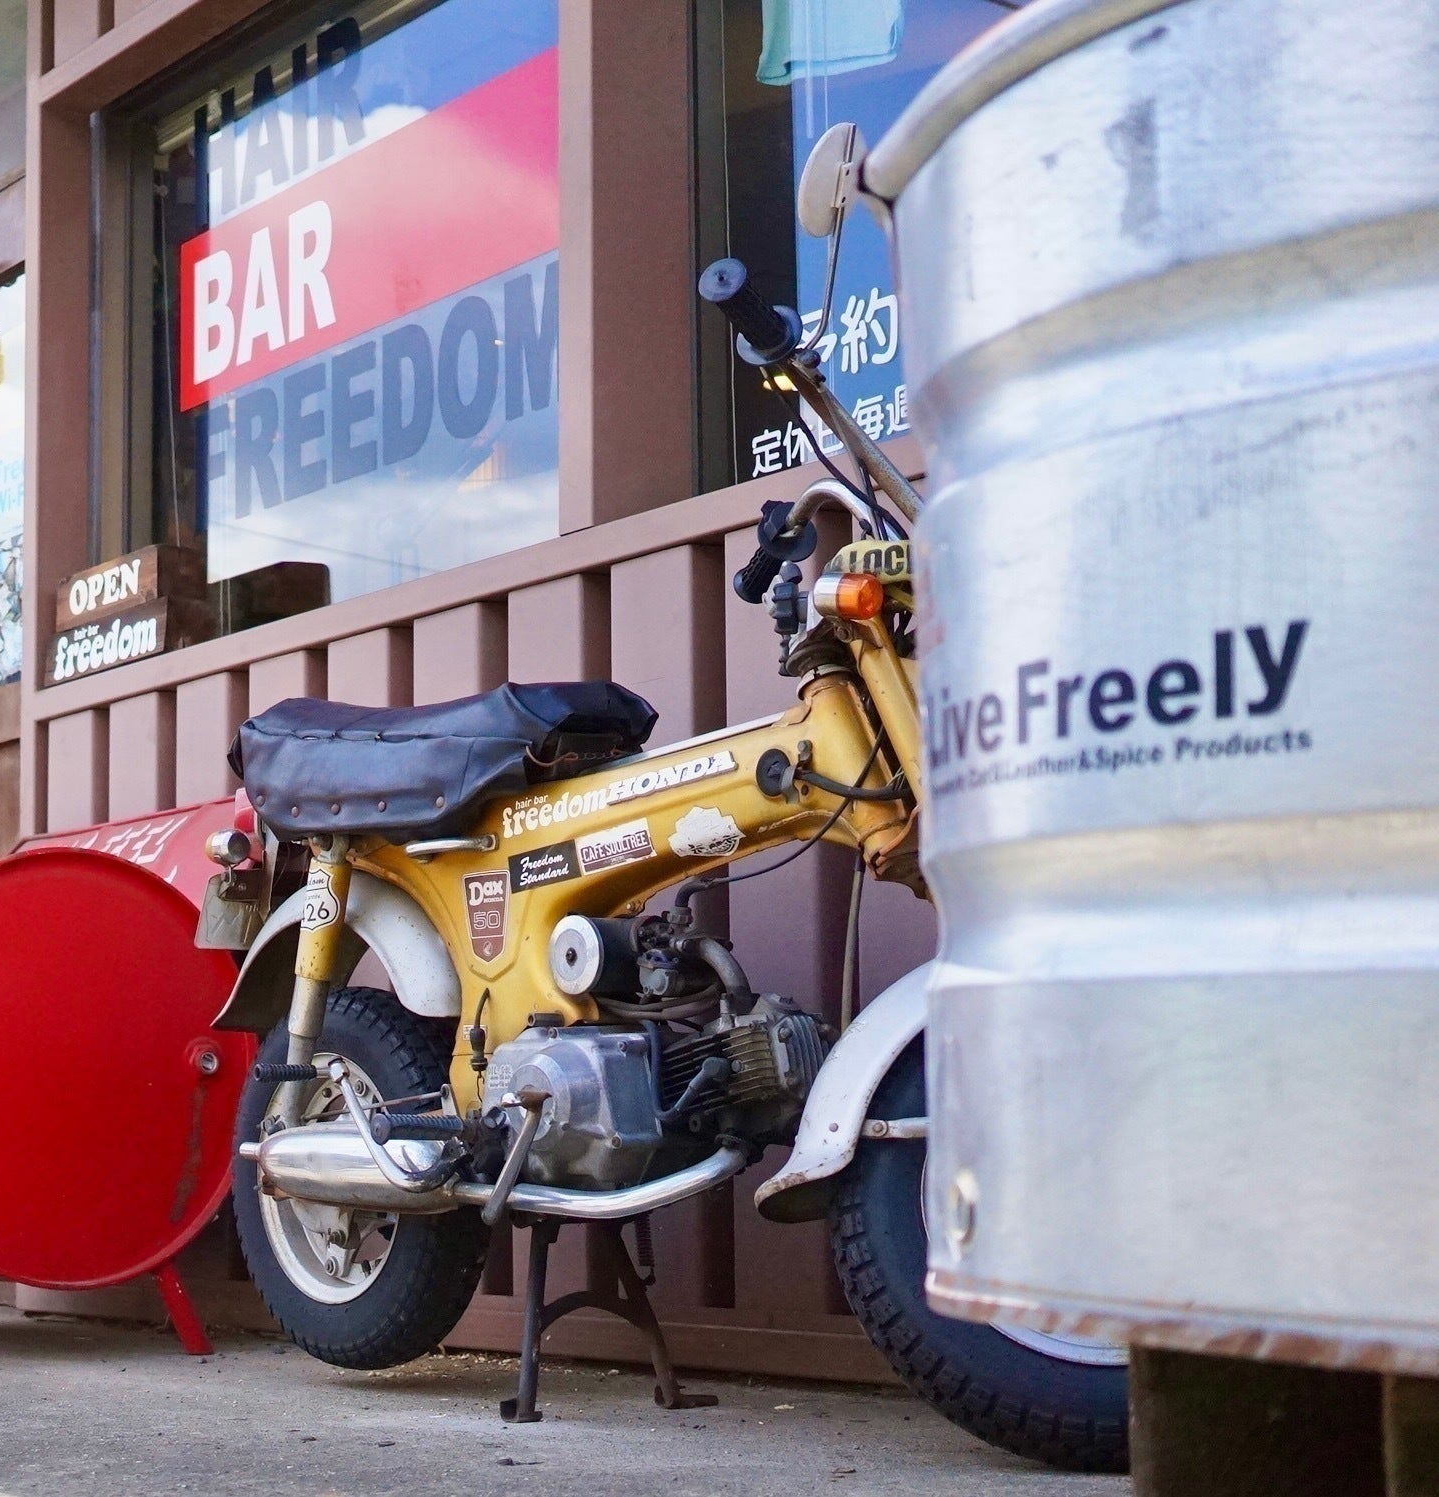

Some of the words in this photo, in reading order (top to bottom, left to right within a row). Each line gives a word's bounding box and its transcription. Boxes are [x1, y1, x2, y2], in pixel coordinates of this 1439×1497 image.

[194, 17, 367, 232] HAIR
[194, 200, 336, 385] BAR
[195, 259, 559, 536] FREEDOM
[69, 559, 141, 615] OPEN
[54, 618, 157, 681] freedom
[928, 687, 1004, 771] Live
[1017, 617, 1311, 745] Freely
[1175, 729, 1311, 761] Products
[515, 797, 534, 810] hair
[534, 793, 549, 805] bar
[608, 750, 737, 805] HONDA
[502, 788, 610, 840] freedom
[519, 864, 570, 887] Standard
[520, 852, 565, 873] Freedom
[468, 880, 504, 906] Dax
[473, 910, 501, 930] 50
